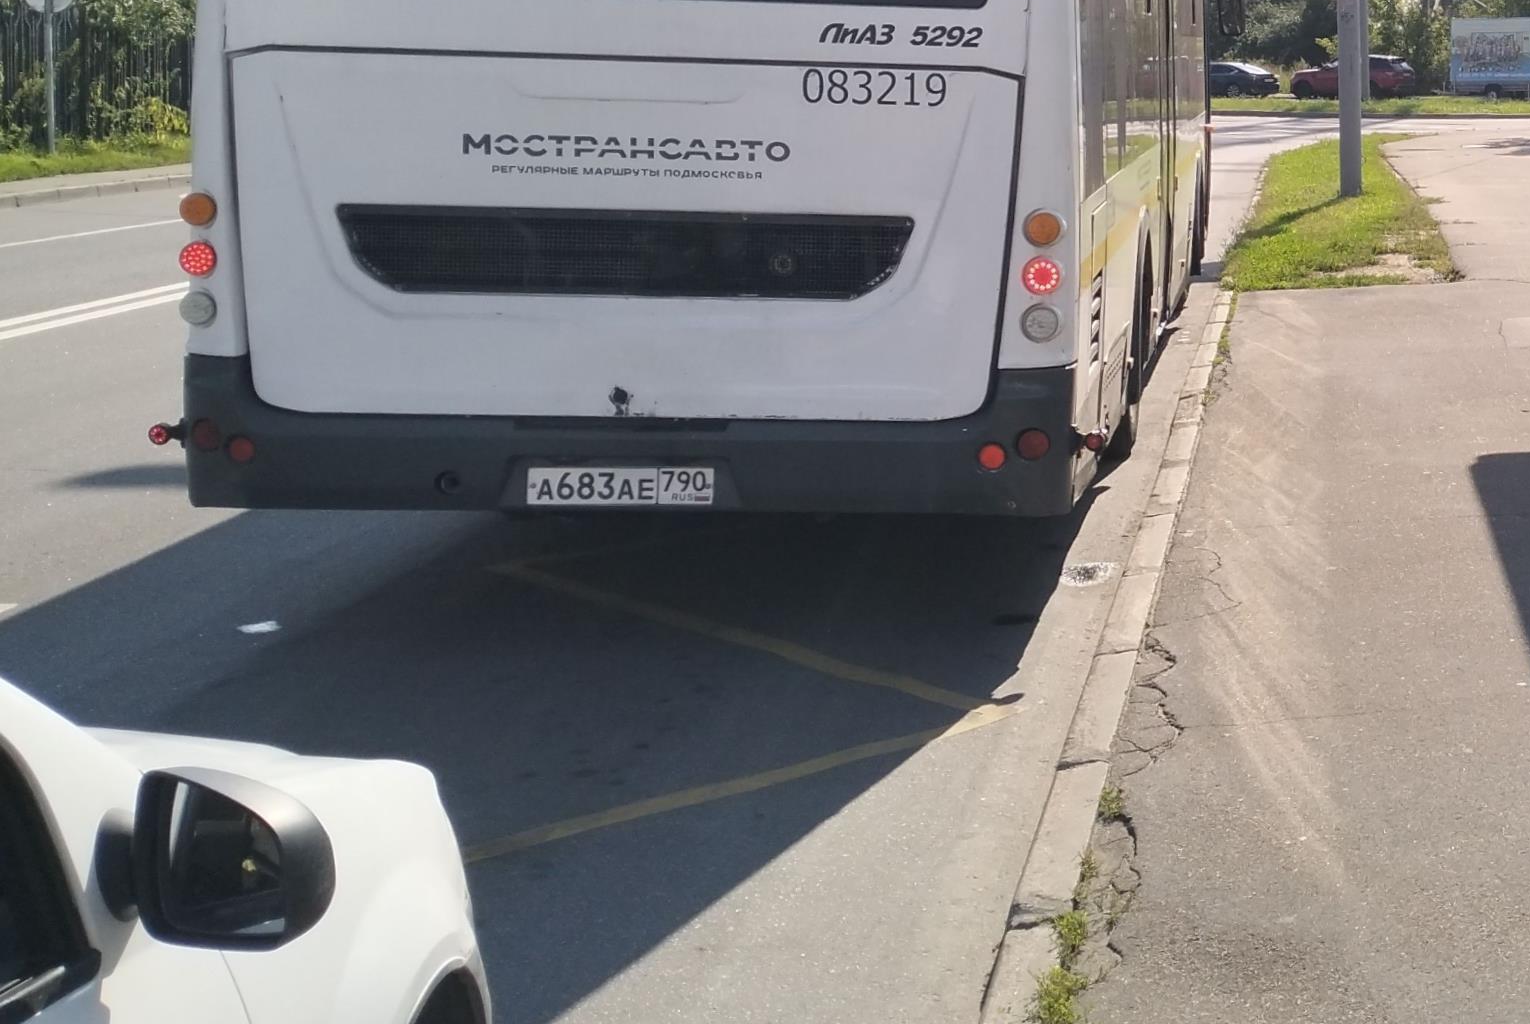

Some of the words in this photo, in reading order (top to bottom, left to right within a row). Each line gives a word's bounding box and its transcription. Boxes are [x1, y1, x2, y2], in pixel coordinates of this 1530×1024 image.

[819, 23, 895, 45] ЛиАЗ
[910, 26, 983, 48] 5292
[802, 68, 947, 107] 083219
[462, 133, 791, 162] МОСТРАНСАВТО
[492, 165, 579, 175] РЕГУЛЯРНЫЕ
[583, 167, 660, 177] МАРШРУТЫ
[661, 471, 706, 492] 790
[672, 493, 693, 501] RUS
